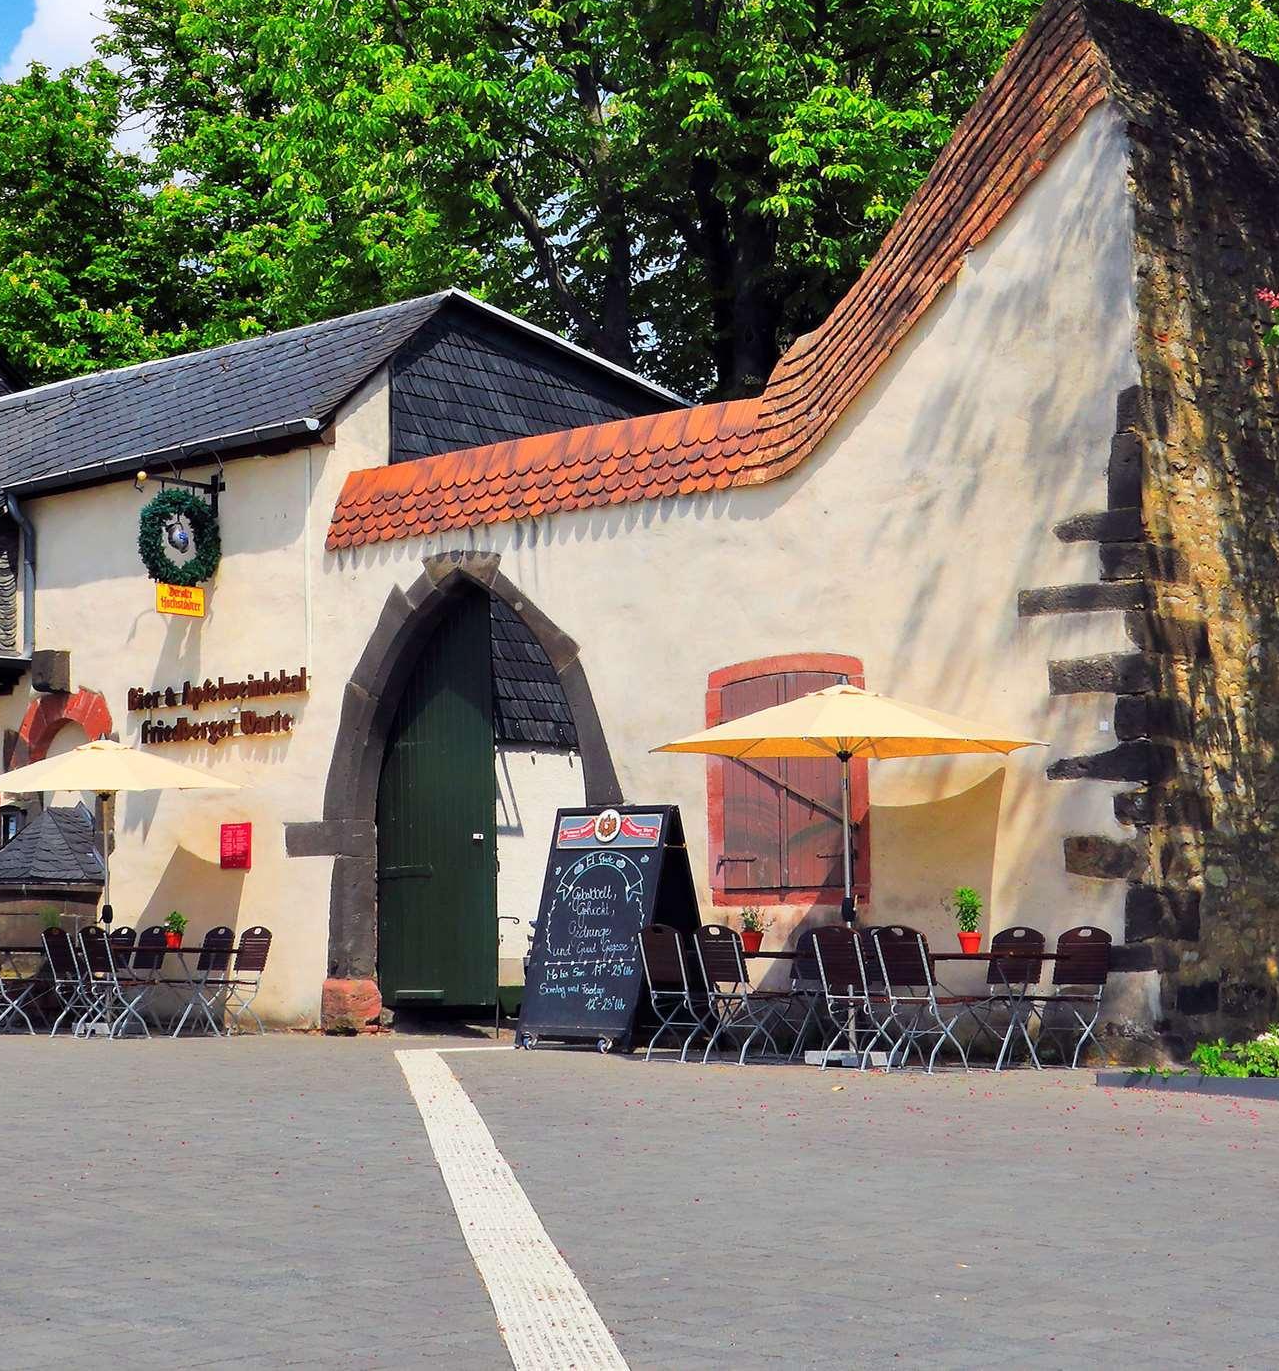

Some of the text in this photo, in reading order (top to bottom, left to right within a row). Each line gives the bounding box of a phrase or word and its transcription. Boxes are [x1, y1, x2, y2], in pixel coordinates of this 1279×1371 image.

[128, 687, 160, 710] Bier
[181, 667, 307, 711] Apfelweinlokal
[141, 711, 293, 746] Friedberger Warte
[546, 968, 559, 981] Mo
